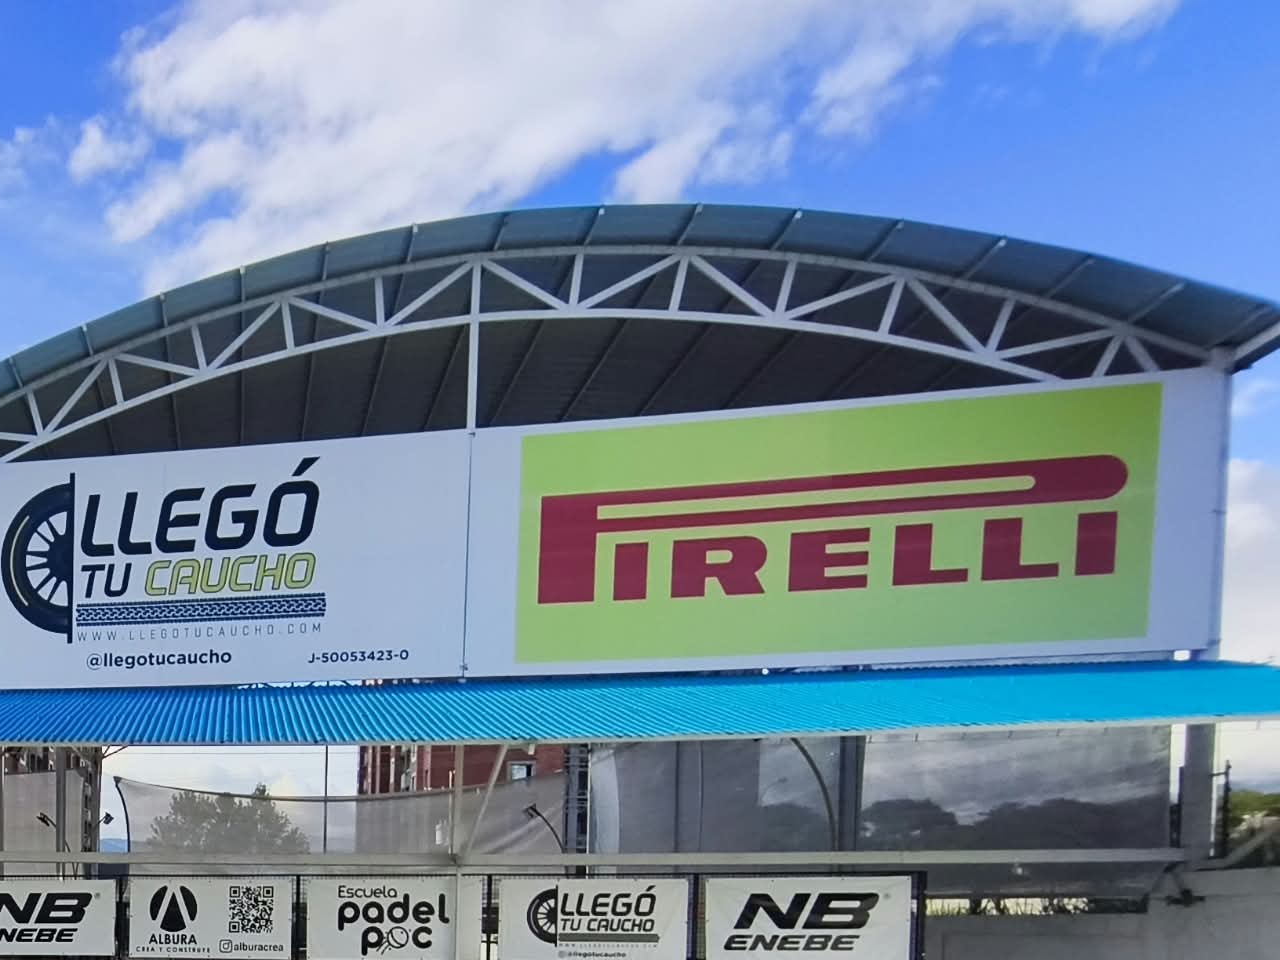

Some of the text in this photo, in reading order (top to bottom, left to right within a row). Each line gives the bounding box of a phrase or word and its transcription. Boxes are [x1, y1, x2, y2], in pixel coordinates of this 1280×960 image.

[80, 456, 321, 557] LLEGÓ
[537, 454, 1129, 604] PIRELLI
[81, 552, 317, 598] TU CAUCHO
[86, 649, 232, 670] @llegotucaucho
[308, 649, 410, 664] J-50053423-0
[337, 885, 398, 898] Escuela
[560, 885, 657, 917] LLEGÓ
[338, 893, 450, 931] padel
[733, 893, 880, 929] NB
[560, 918, 656, 932] TU CAUCHO
[149, 933, 198, 945] ALBURA
[233, 942, 284, 952] alburacrea
[724, 934, 860, 951] ENEBE
